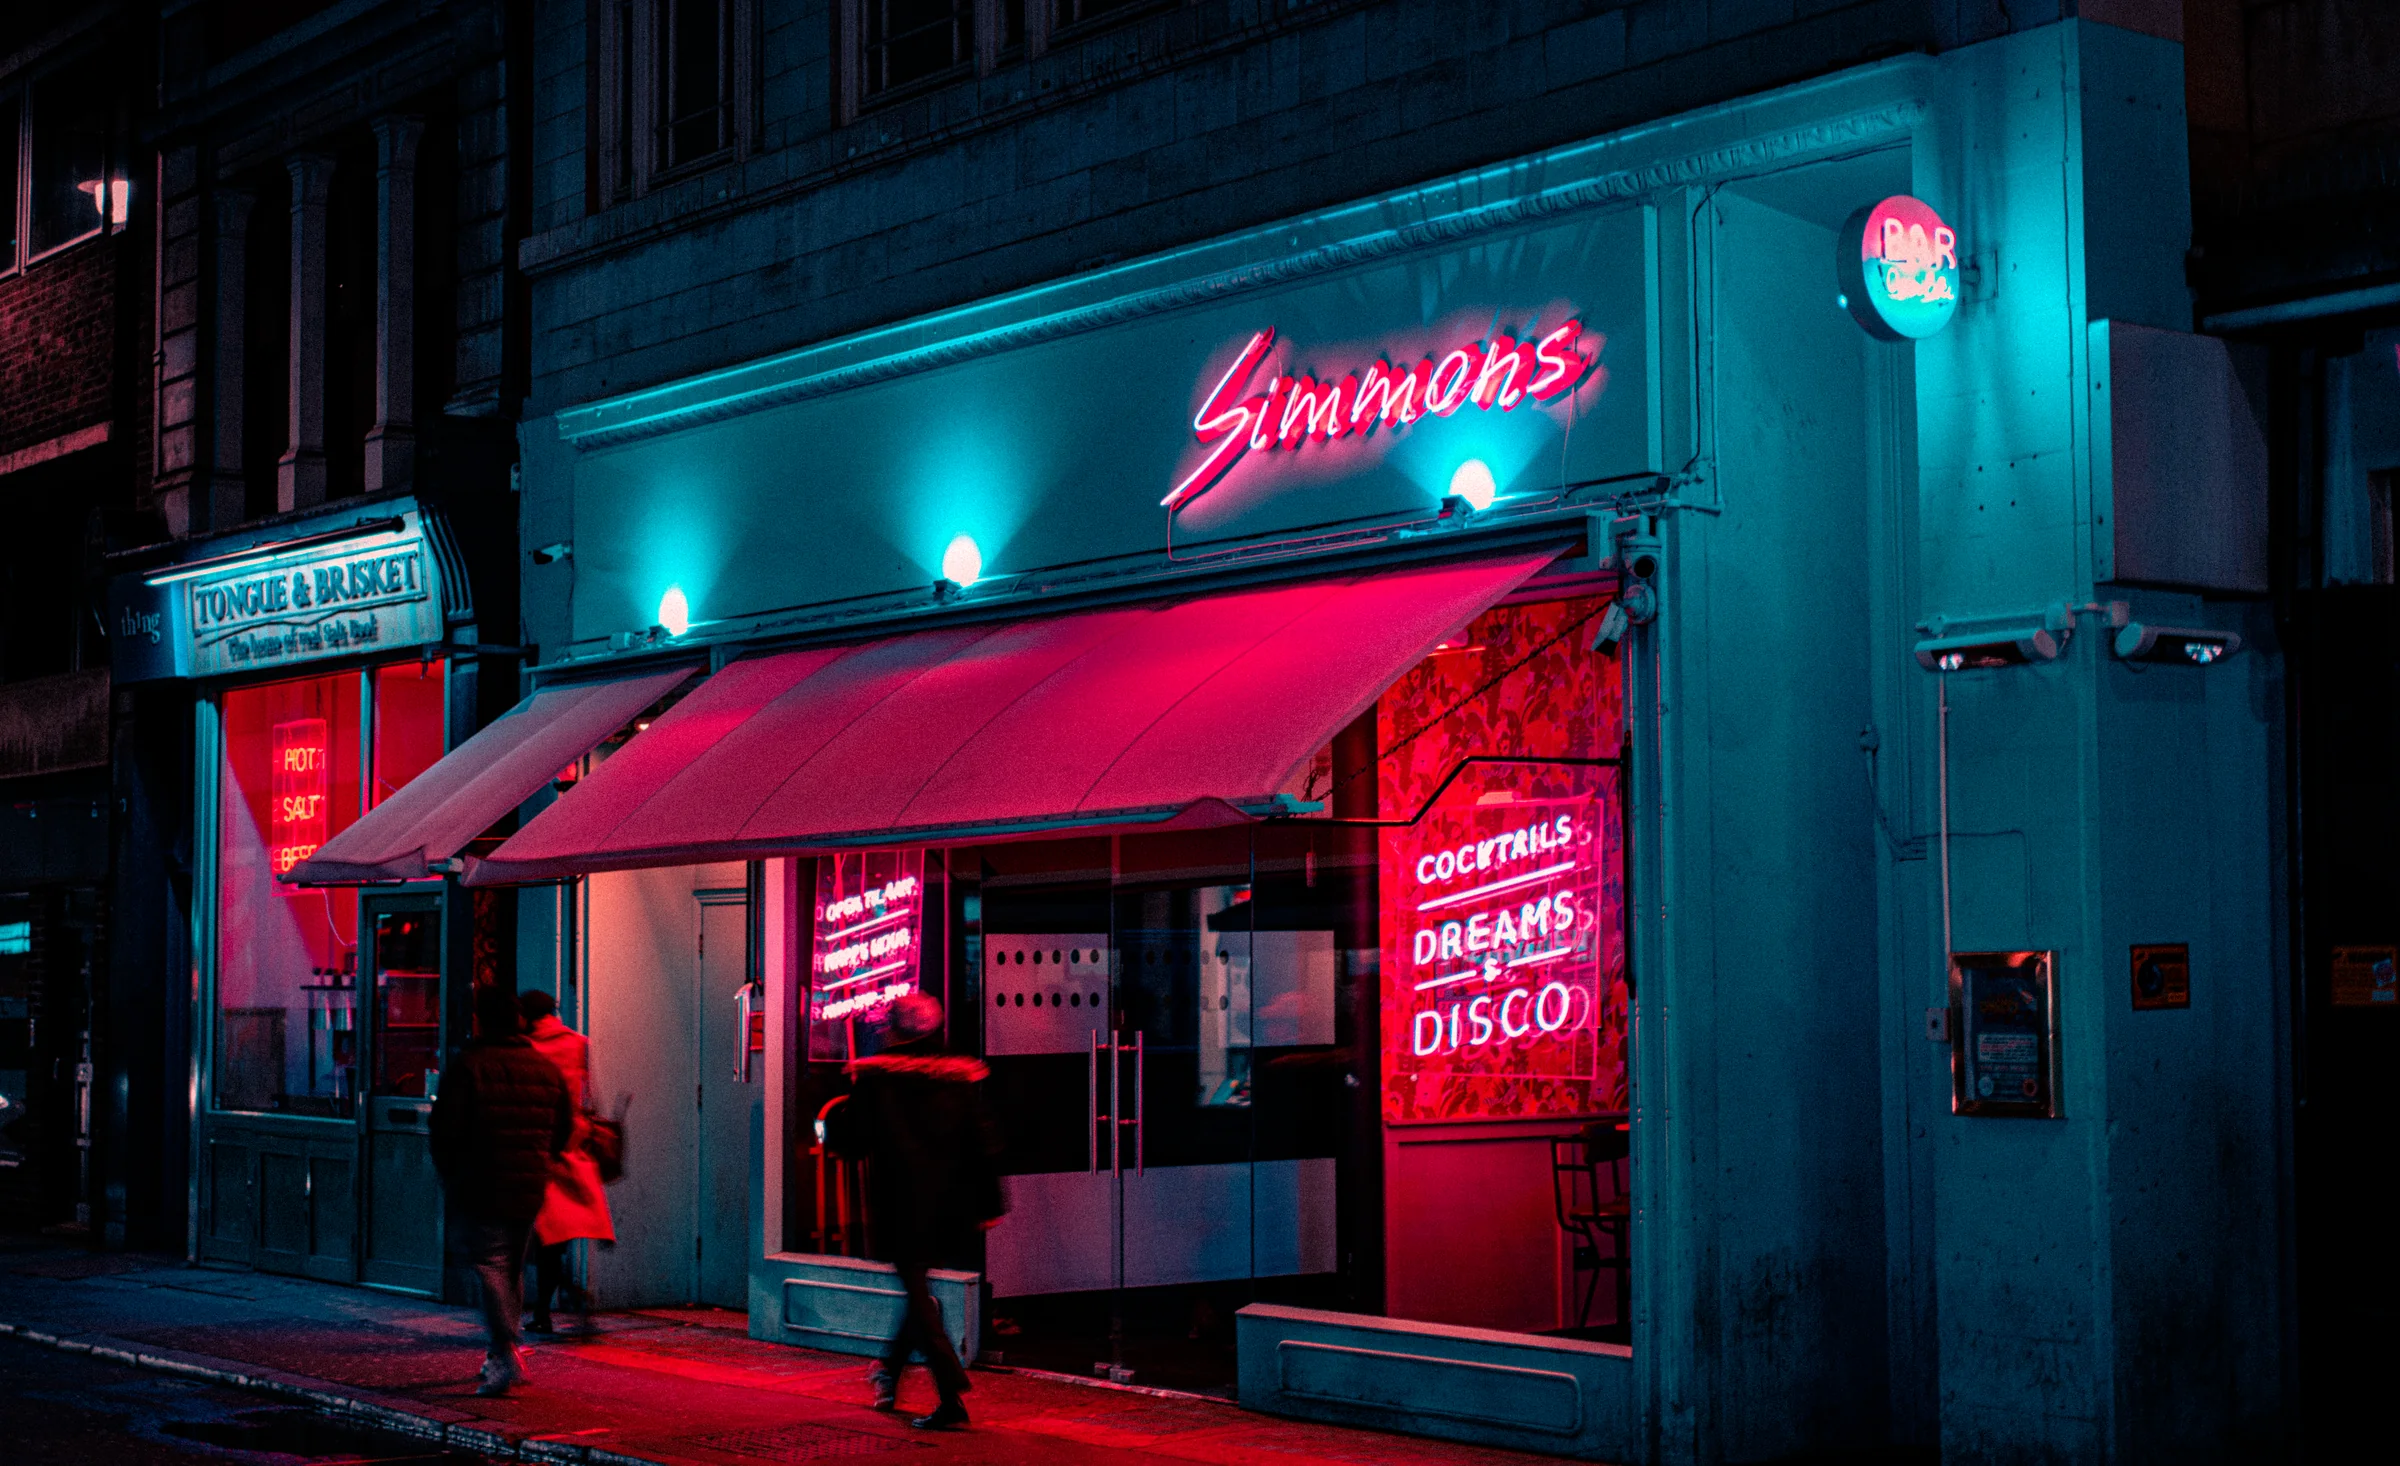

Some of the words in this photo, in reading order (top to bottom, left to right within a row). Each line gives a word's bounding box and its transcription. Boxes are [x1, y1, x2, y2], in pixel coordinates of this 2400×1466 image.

[1884, 218, 1957, 269] BAR
[1161, 320, 1590, 509] Simmons
[196, 575, 287, 624] TONGUE
[291, 571, 310, 609] &
[313, 551, 417, 603] BRISKET
[284, 748, 316, 772] HOT
[283, 795, 320, 823] SALT
[1416, 814, 1572, 884] COCKTAILS
[1414, 890, 1575, 966] DREAMS
[1414, 981, 1570, 1057] DISCO
